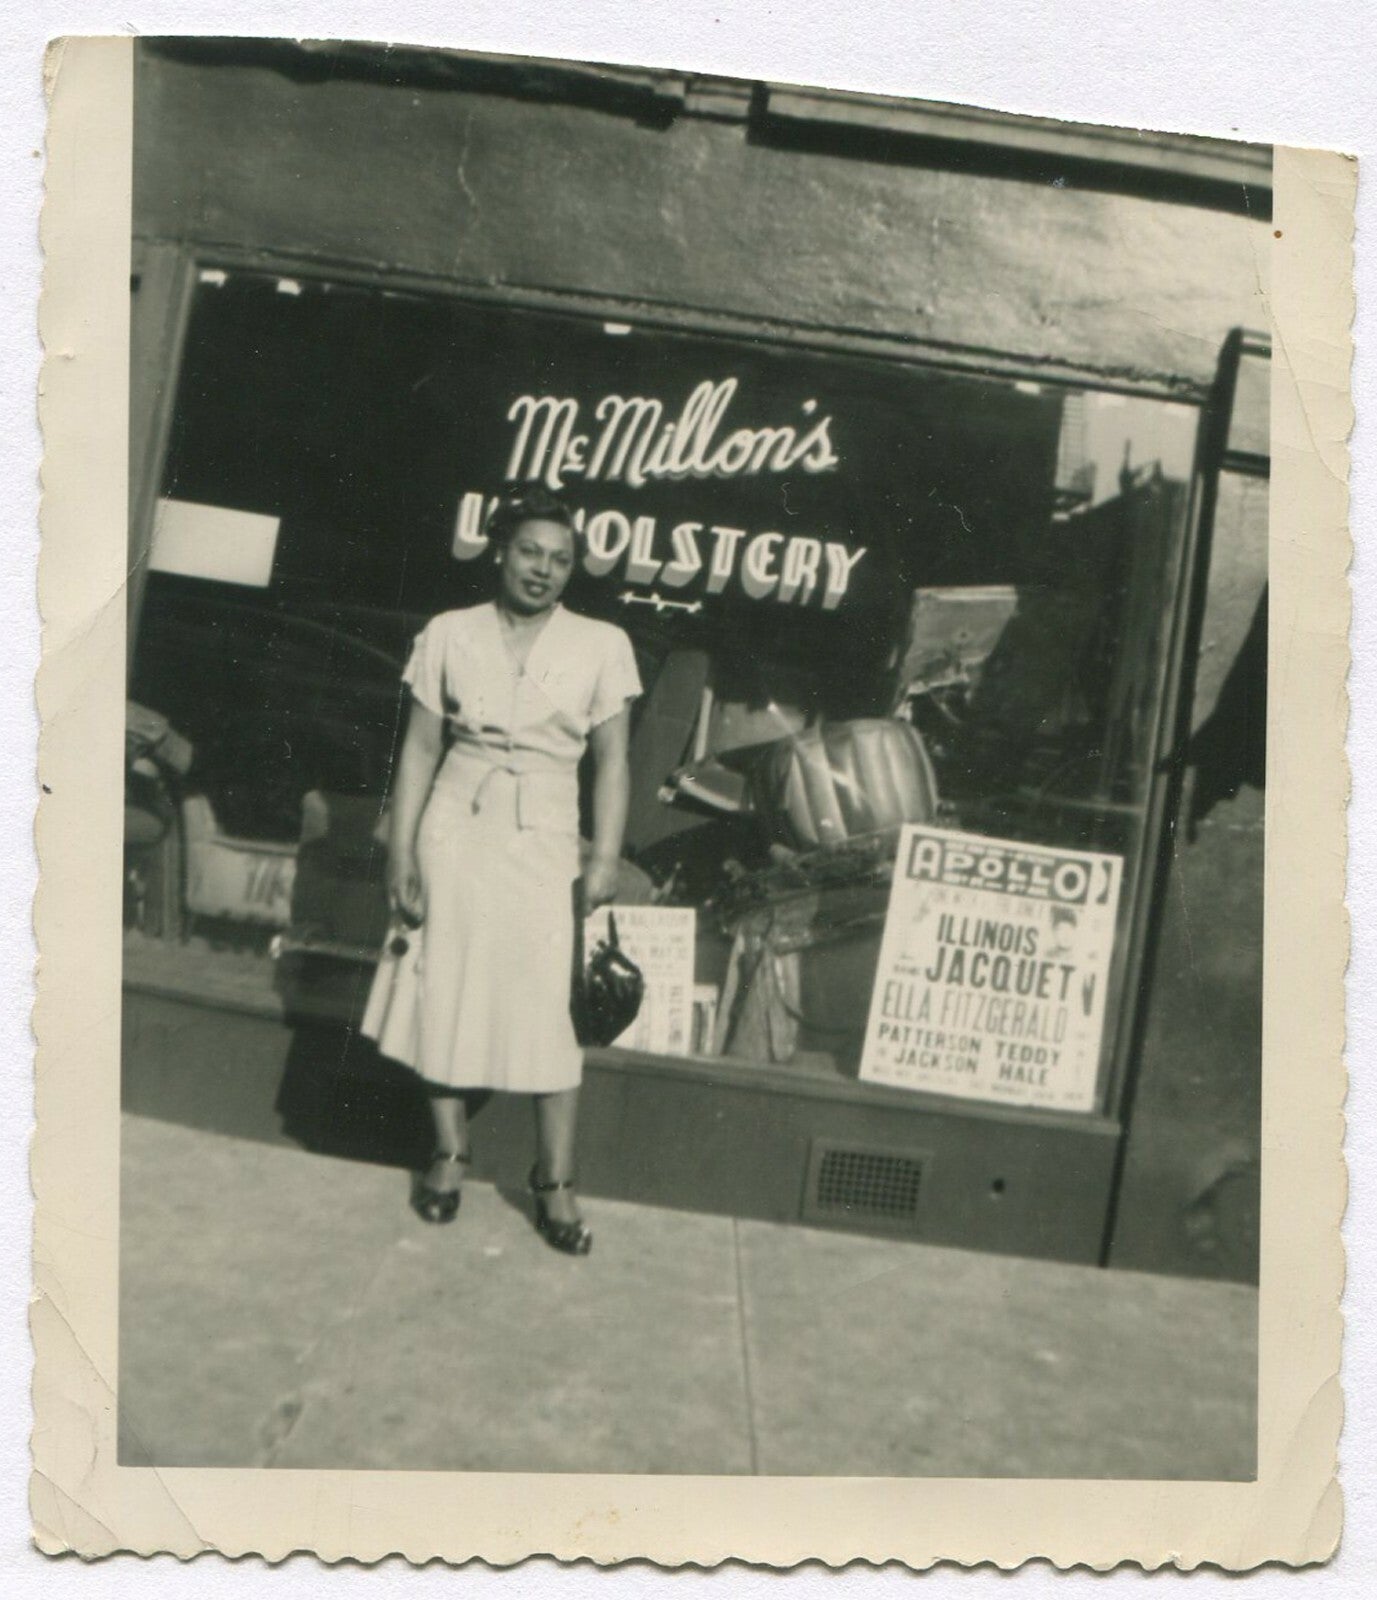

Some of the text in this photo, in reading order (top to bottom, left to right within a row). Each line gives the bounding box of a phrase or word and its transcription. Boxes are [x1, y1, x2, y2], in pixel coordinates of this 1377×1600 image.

[505, 377, 838, 489] McMillon's
[452, 492, 867, 608] UOLSTERY
[911, 838, 1087, 900] APOLLO
[937, 913, 1038, 957] ILLINOIS
[925, 947, 1076, 1001] JACQUET
[881, 979, 1068, 1044] ELLA FITZGERALD
[877, 1022, 981, 1054] PATTERSON
[894, 1048, 978, 1074] JACKSON
[996, 1041, 1061, 1067] TEDDY
[998, 1065, 1050, 1087] HALE
